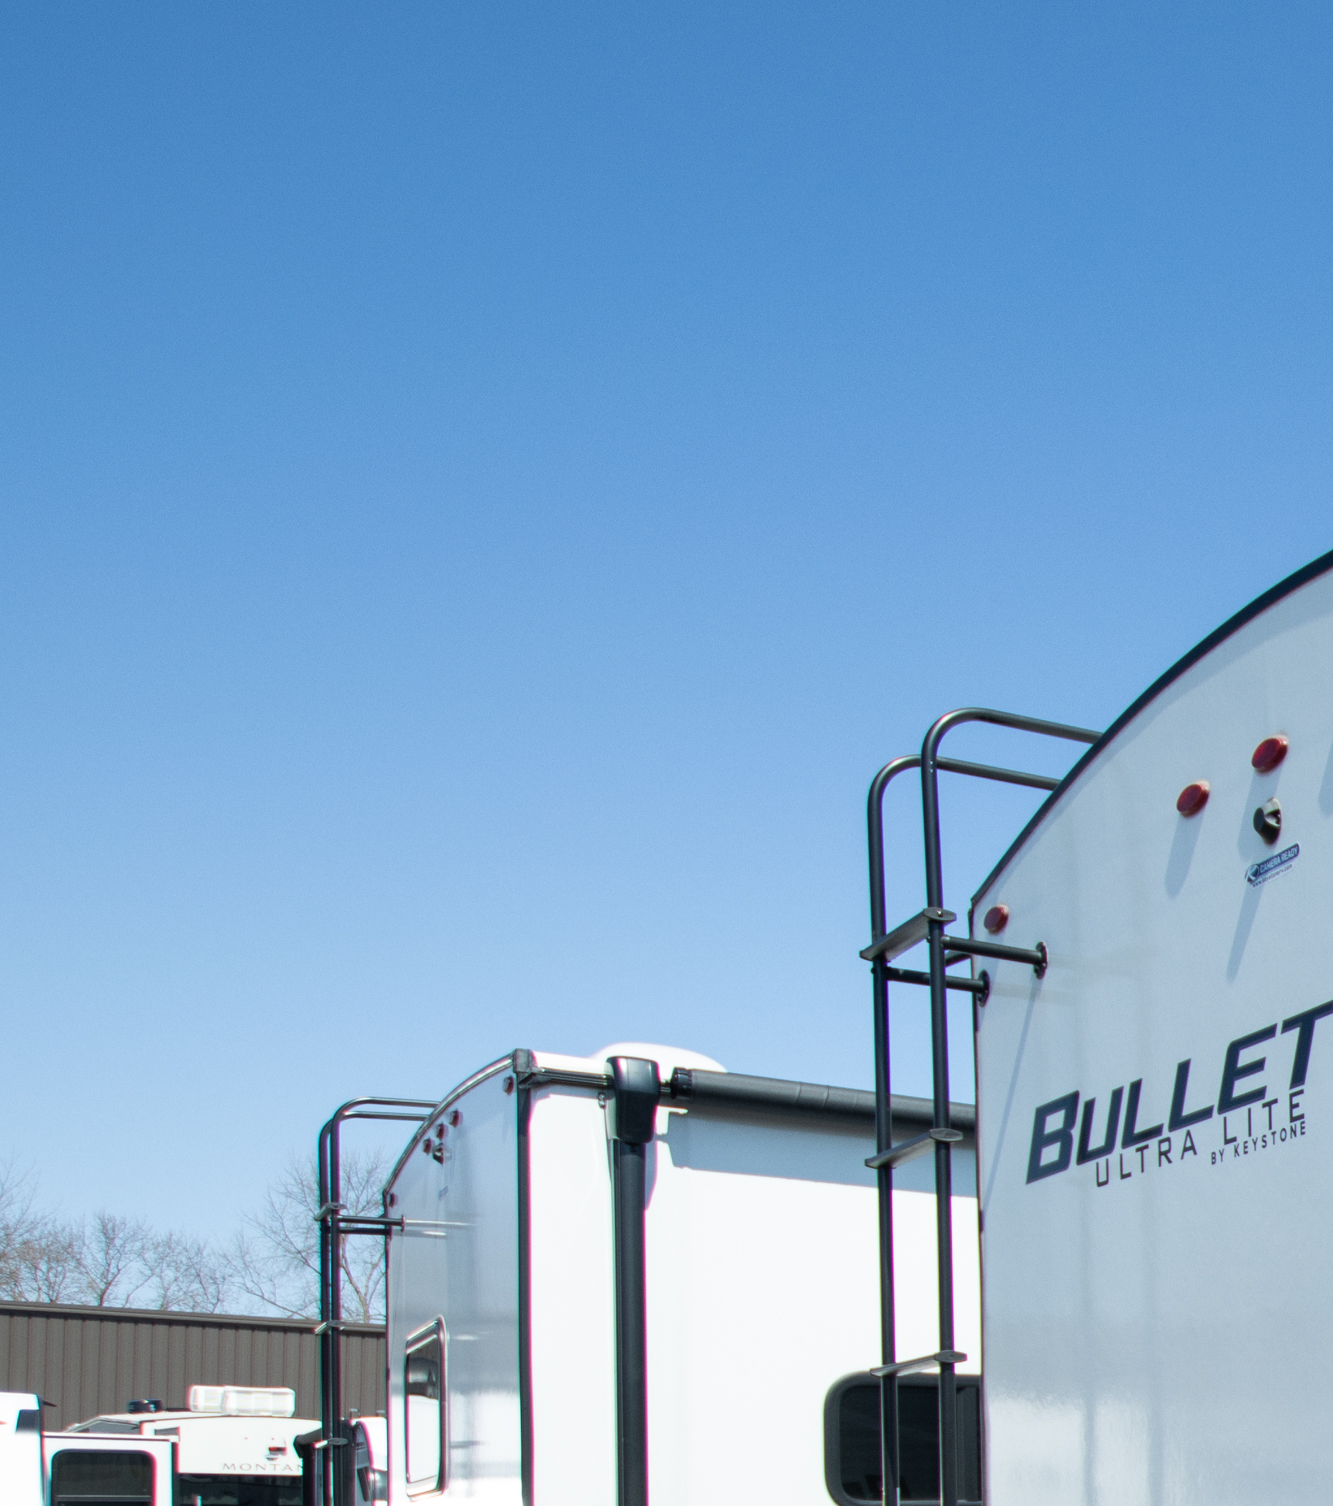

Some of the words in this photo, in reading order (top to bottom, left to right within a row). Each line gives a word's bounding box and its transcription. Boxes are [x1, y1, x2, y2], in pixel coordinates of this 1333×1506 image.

[1095, 1129, 1198, 1188] ULTRA
[1223, 1089, 1305, 1145] LITE
[1211, 1149, 1225, 1165] BY
[1234, 1120, 1306, 1158] KEYSTONE
